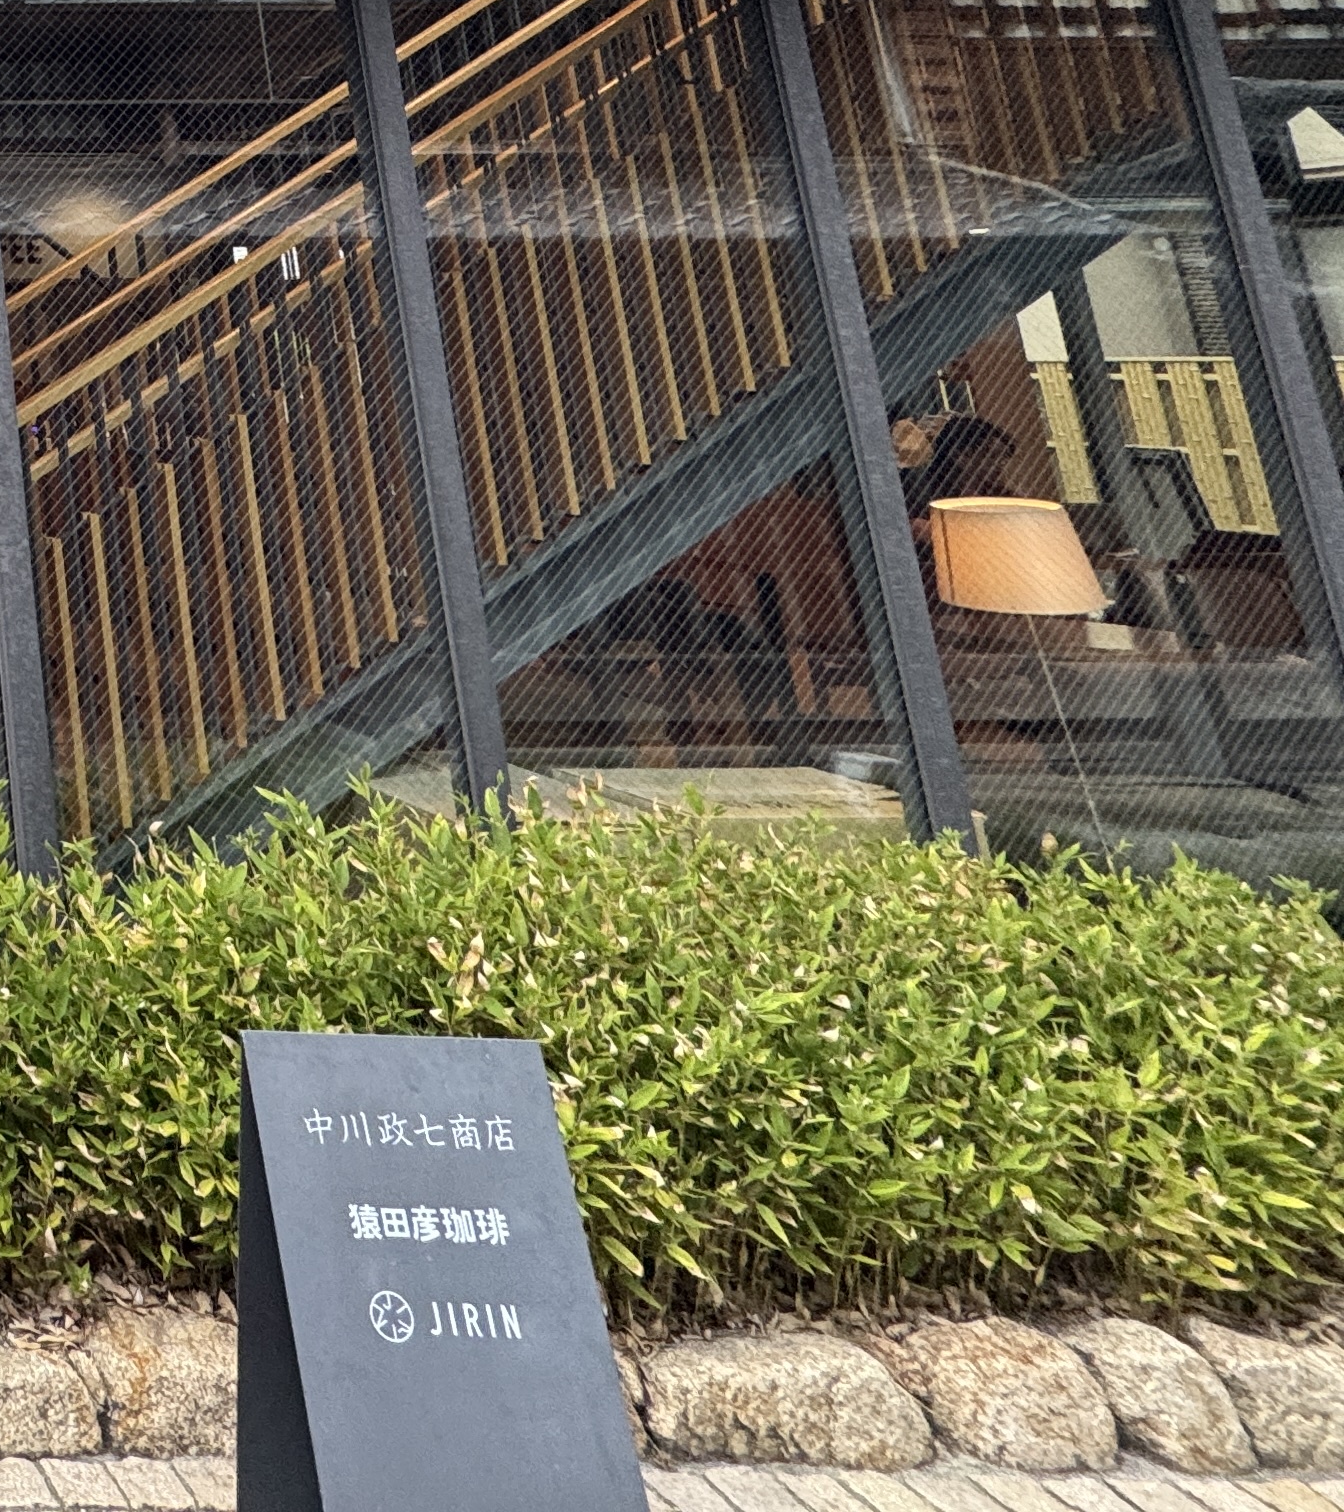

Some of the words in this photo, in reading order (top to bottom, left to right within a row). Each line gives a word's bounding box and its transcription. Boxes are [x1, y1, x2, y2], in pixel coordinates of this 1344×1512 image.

[303, 1108, 515, 1151] 中川政七商店
[348, 1204, 510, 1245] 猿田彦珈琲
[431, 1301, 522, 1339] JIRIN
